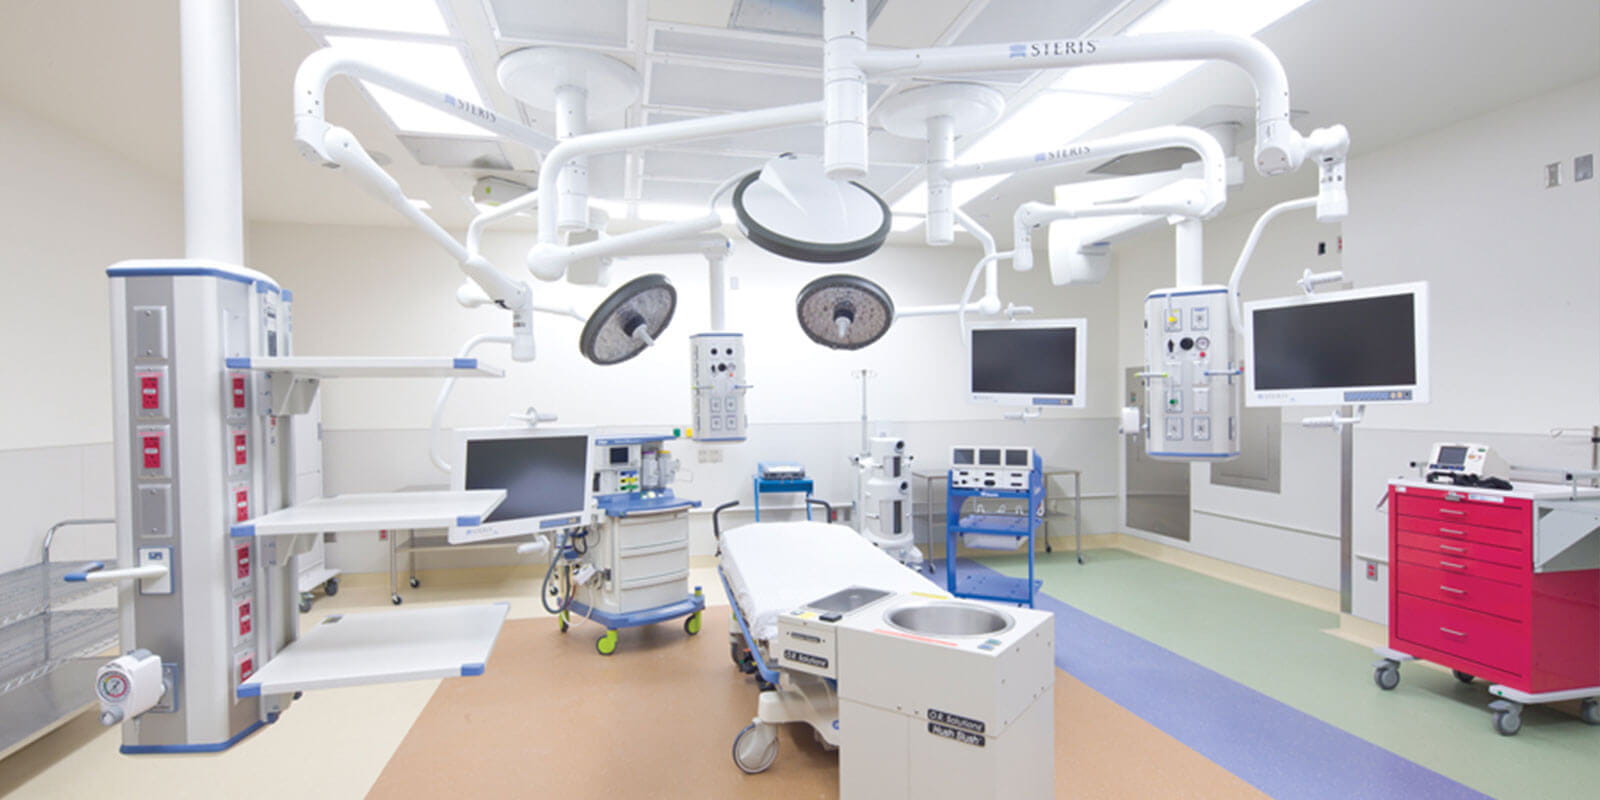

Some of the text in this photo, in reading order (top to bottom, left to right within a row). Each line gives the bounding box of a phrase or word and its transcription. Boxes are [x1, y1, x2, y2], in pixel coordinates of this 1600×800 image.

[1031, 41, 1096, 57] STERIS
[458, 98, 497, 123] STERIS
[1048, 145, 1091, 160] STERIS
